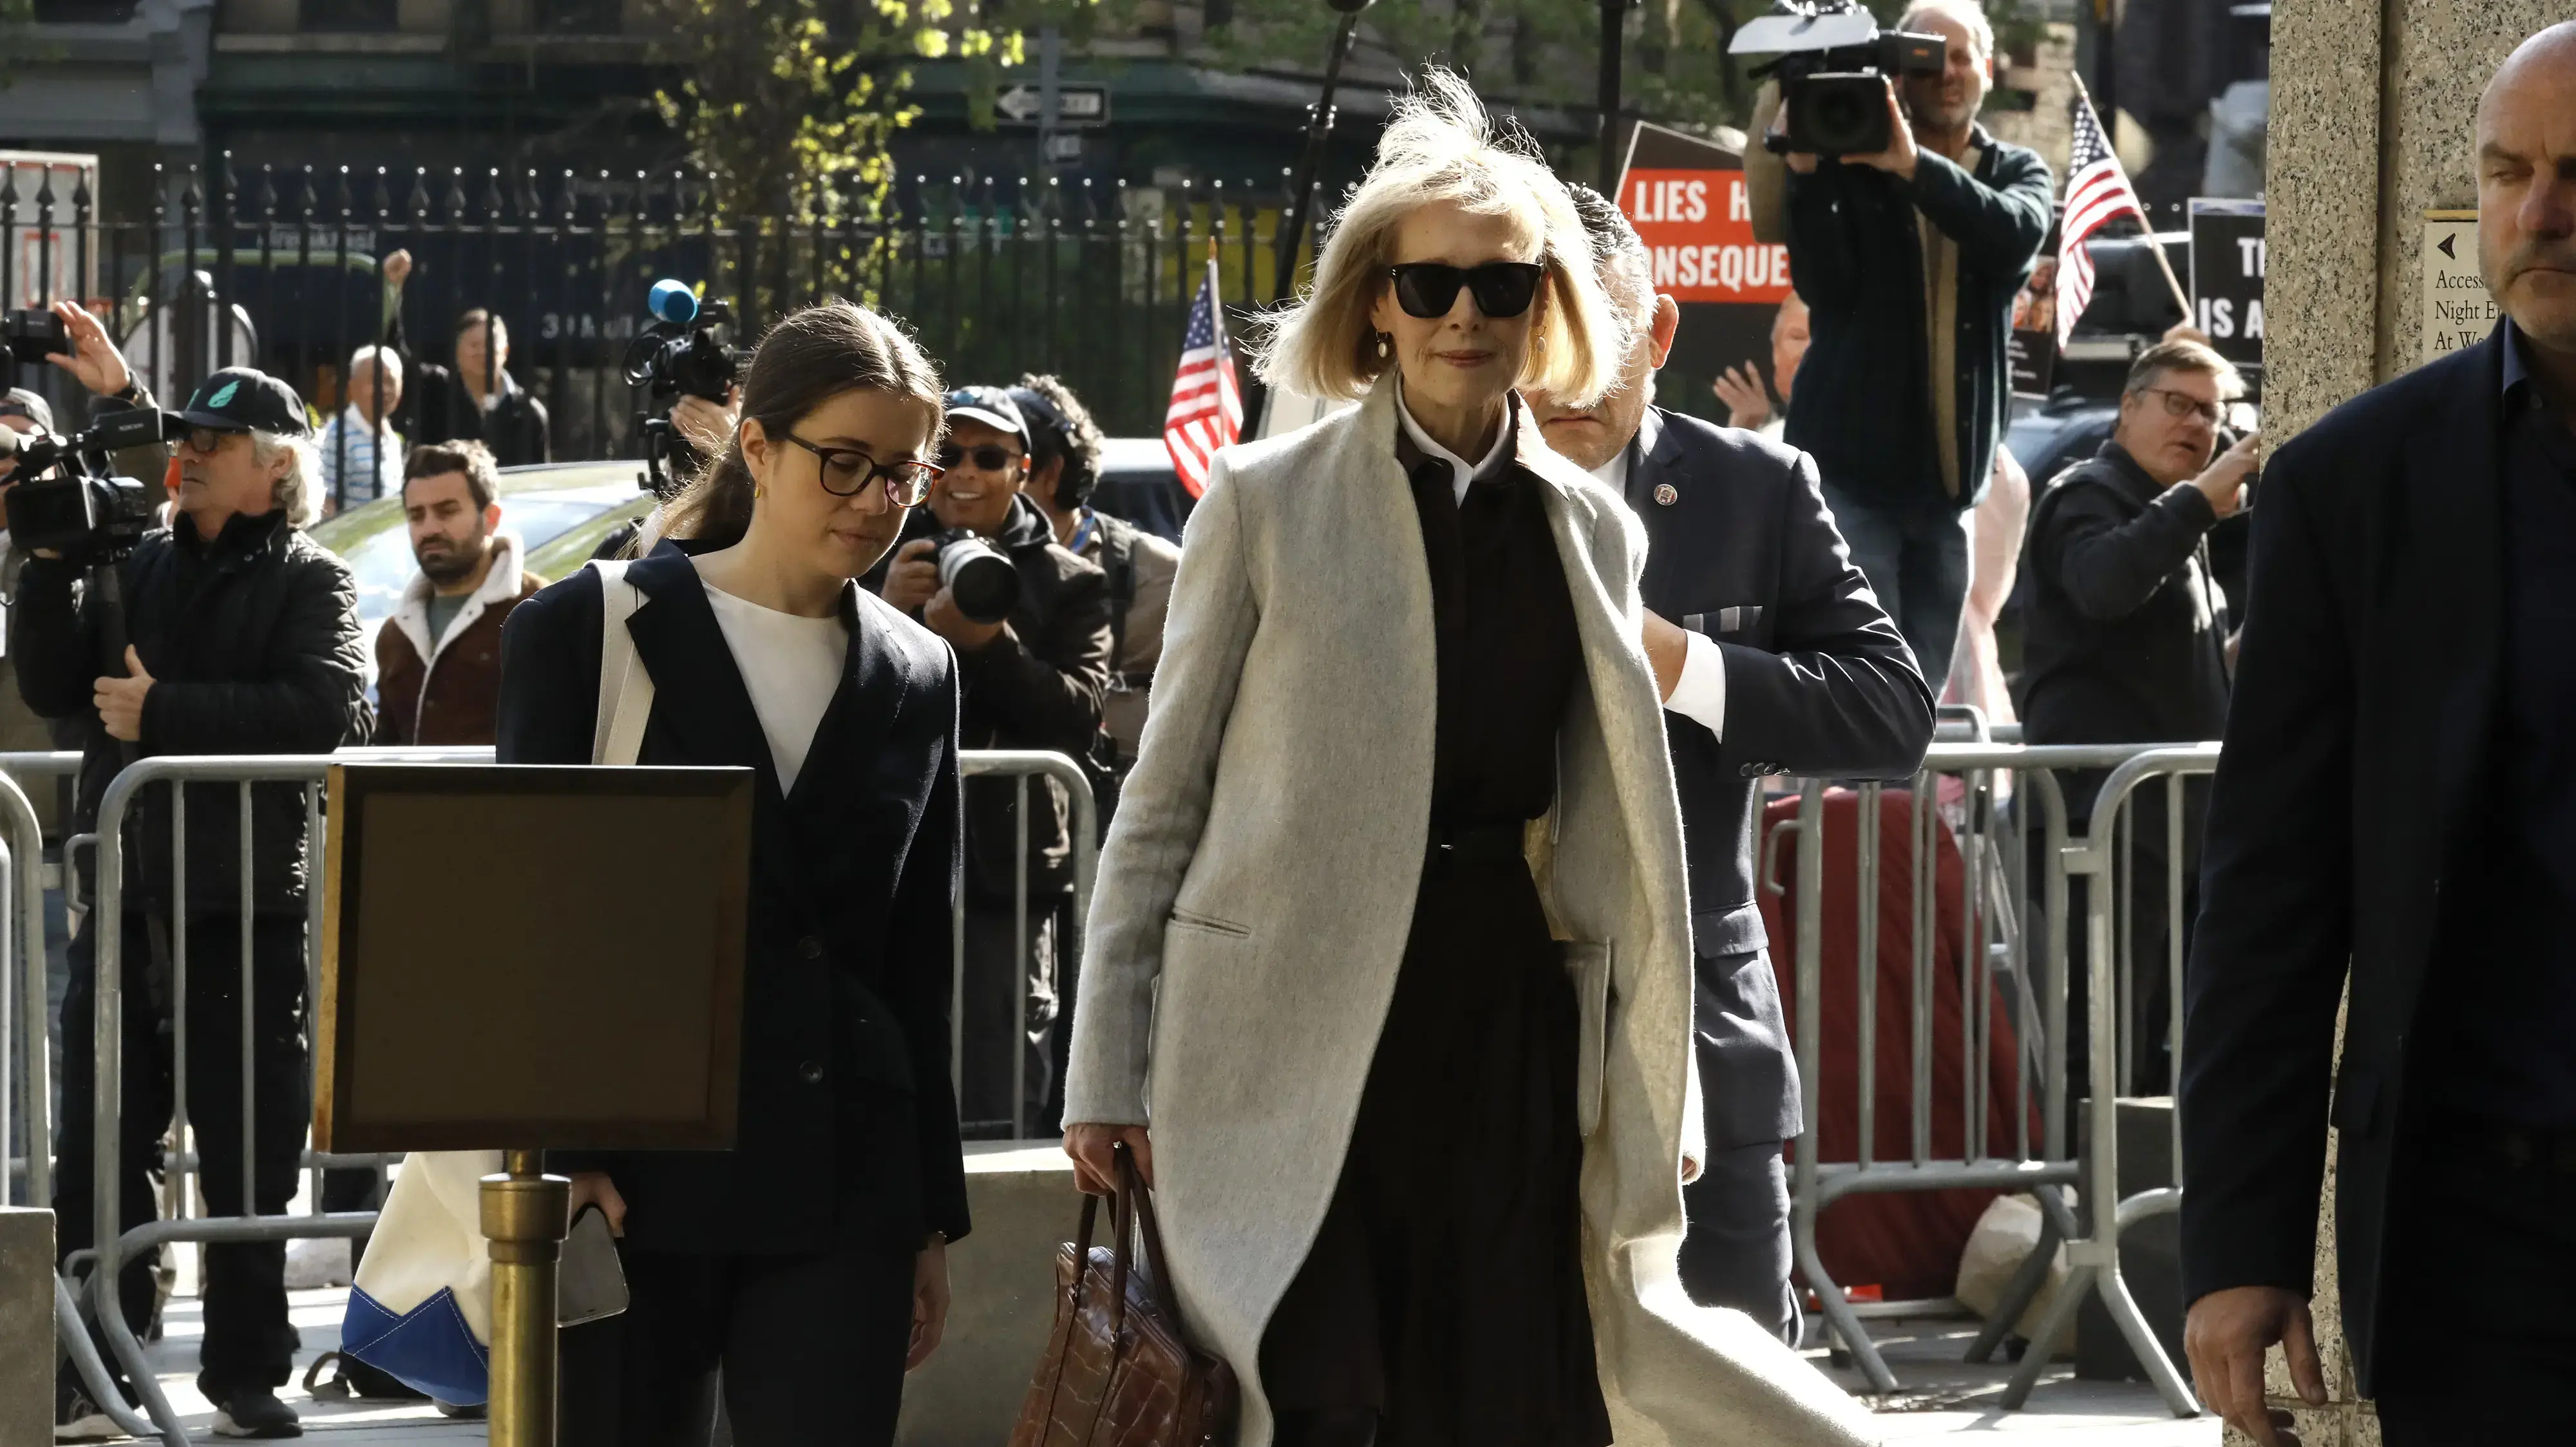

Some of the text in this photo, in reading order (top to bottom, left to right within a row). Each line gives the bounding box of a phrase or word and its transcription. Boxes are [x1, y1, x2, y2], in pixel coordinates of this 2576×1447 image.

[1634, 180, 1707, 222] LIES
[2199, 297, 2234, 338] IS
[2435, 299, 2480, 325] Night
[2434, 330, 2454, 350] At
